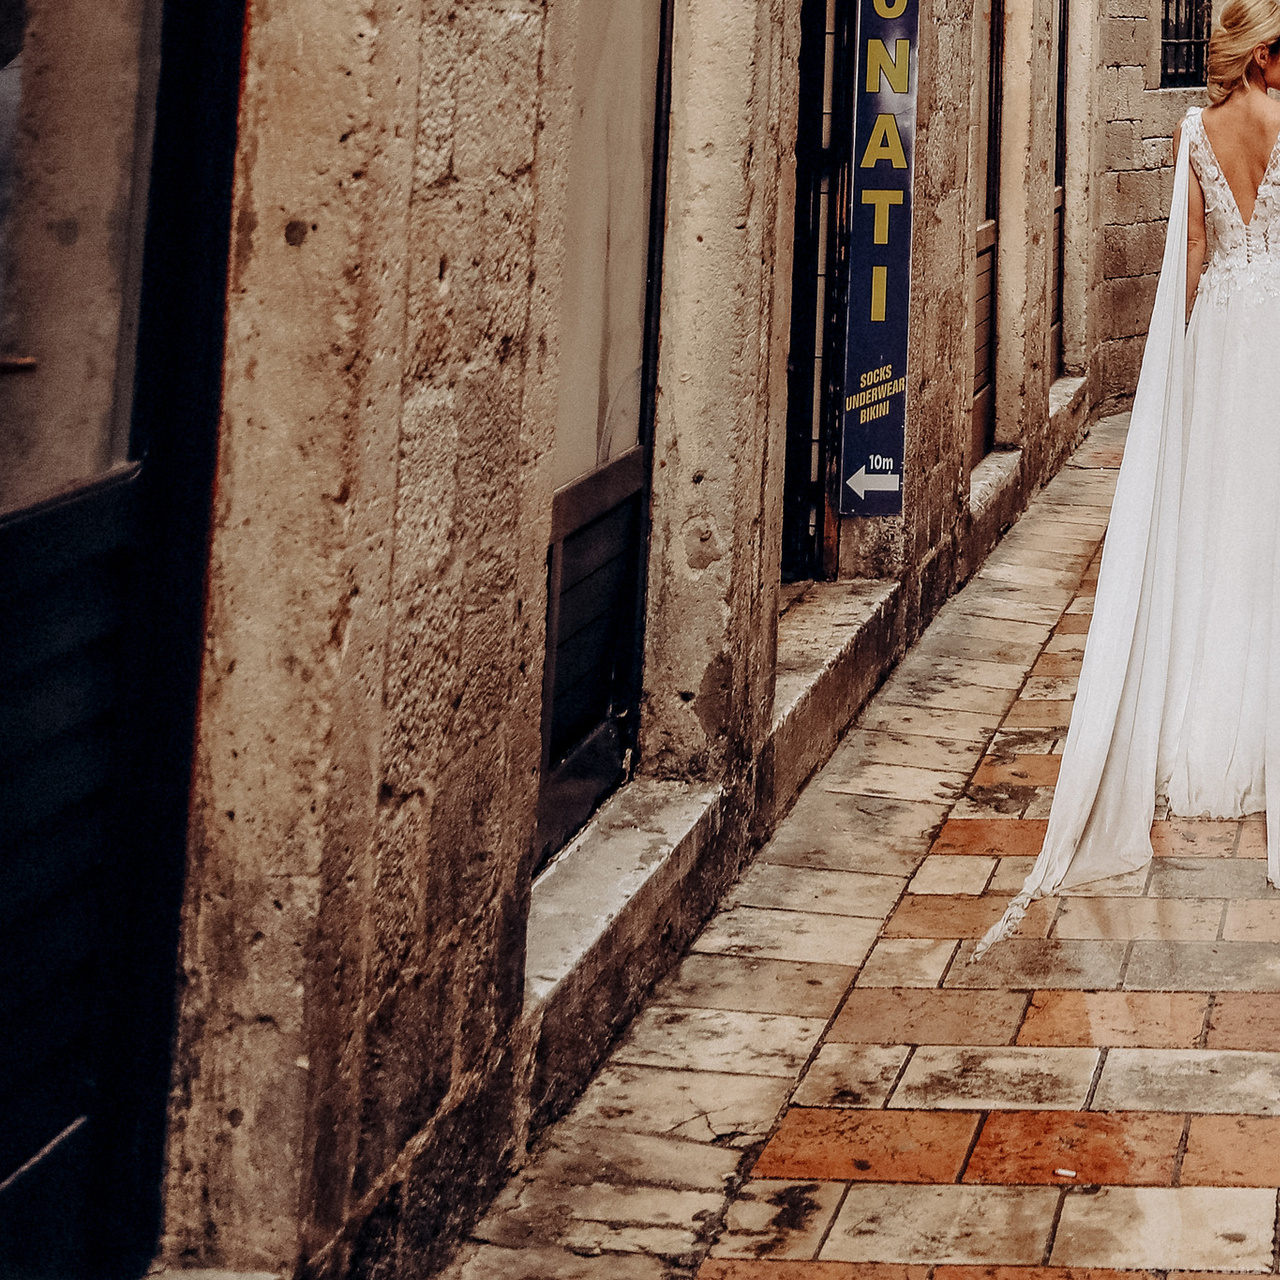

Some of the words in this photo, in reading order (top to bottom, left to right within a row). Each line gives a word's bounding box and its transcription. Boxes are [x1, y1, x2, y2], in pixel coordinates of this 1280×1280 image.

[860, 364, 892, 389] SOCKS
[845, 377, 906, 412] UNDERWEAR
[860, 400, 890, 425] BIKINI
[869, 454, 893, 470] 10m
